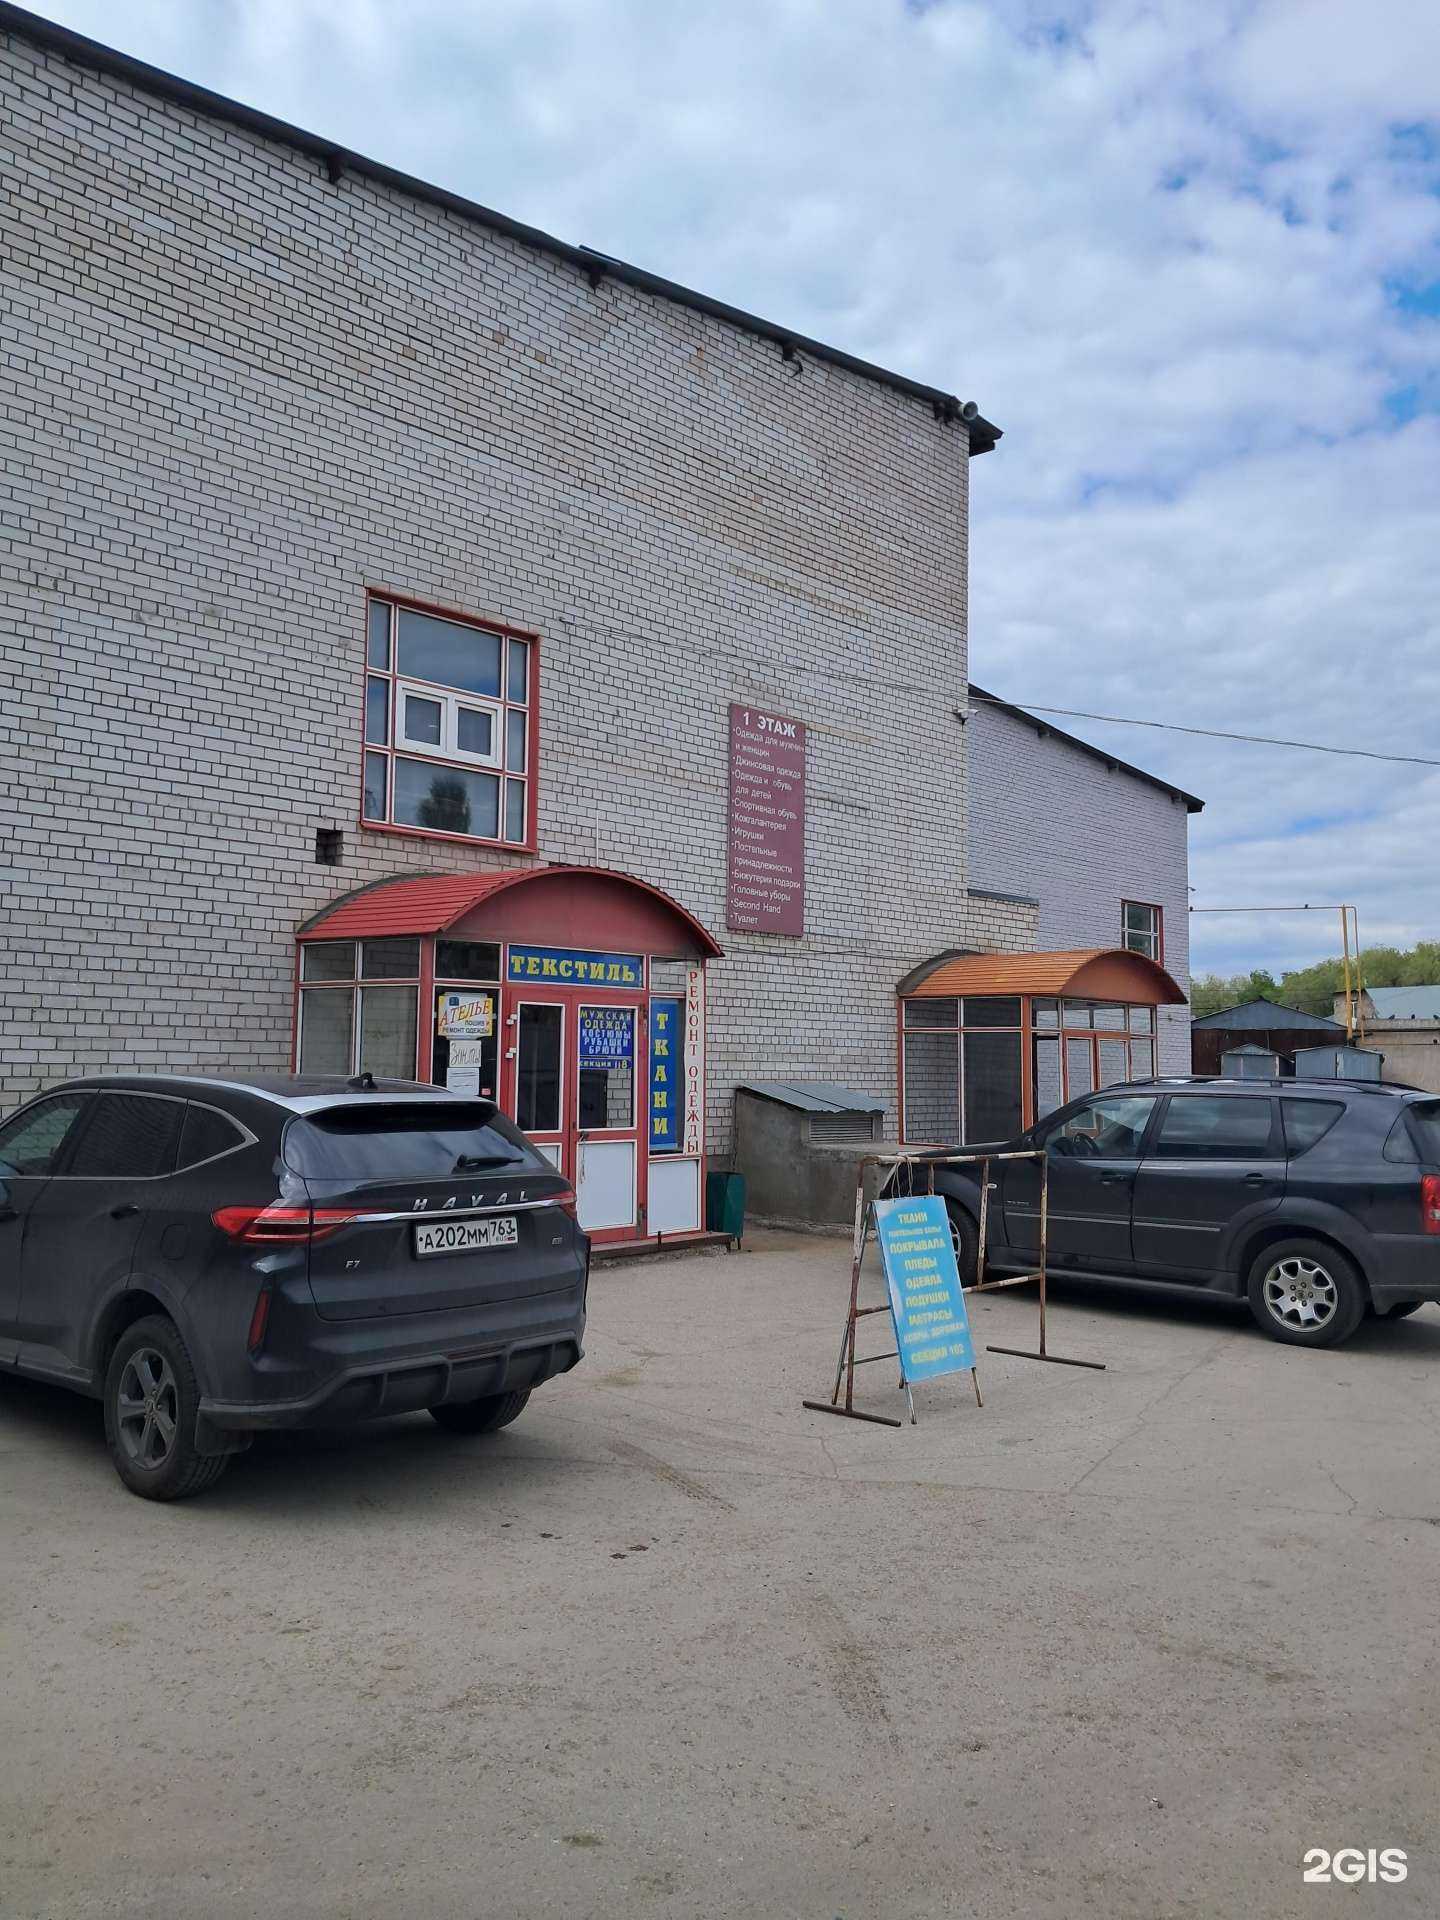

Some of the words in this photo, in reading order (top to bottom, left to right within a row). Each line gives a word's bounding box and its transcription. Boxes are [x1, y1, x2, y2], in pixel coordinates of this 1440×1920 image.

[743, 712, 750, 726] 1
[757, 715, 796, 738] ЭТАЖ
[735, 726, 764, 743] Одежда
[765, 736, 778, 747] для
[742, 745, 770, 757] женщин
[735, 755, 775, 772] Джинсовая
[777, 766, 802, 779] одежда
[734, 769, 763, 785] Одежда
[772, 780, 792, 792] обувь
[735, 785, 749, 795] для
[751, 788, 772, 799] детей
[734, 798, 776, 815] Спортивная
[777, 808, 798, 820] обувь
[734, 812, 787, 831] Кожгалантерея
[734, 826, 764, 840] Игрушки
[734, 840, 777, 857] Постельные
[734, 857, 793, 874] принадлежности
[773, 877, 801, 889] подарки
[733, 883, 768, 898] Головные
[769, 889, 791, 901] уборы
[733, 898, 760, 910] Second
[763, 903, 781, 914] Hand
[733, 912, 758, 924] Туалет
[511, 955, 636, 982] ТЕКСТИЛЬ
[439, 1000, 491, 1026] АТЕЛЬЕ
[580, 1010, 631, 1020] МУЖСКАЯ
[687, 971, 700, 1056] РЕМОНТ
[584, 1019, 628, 1030] ОДЕЖДА
[582, 1029, 631, 1039] КОСТЮМЫ
[584, 1037, 628, 1047] РУБАШКИ
[589, 1045, 622, 1054] БРЮКИ
[653, 1013, 669, 1135] ТКАНИ
[687, 1065, 700, 1153] ОДЕЖДЫ
[413, 1191, 528, 1210] HAVAL
[898, 1212, 928, 1224] ТКАНИ
[424, 1225, 489, 1249] А202ММ
[490, 1219, 512, 1236] 763
[889, 1238, 946, 1254] ПОКРЫВАЛА
[345, 1259, 360, 1269] F7
[904, 1257, 937, 1270] ПЛЕДЫ
[906, 1274, 942, 1289] ОДЕЯЛА
[906, 1290, 949, 1308] ПОДУШКИ
[908, 1308, 953, 1326] МАТРАСЫ
